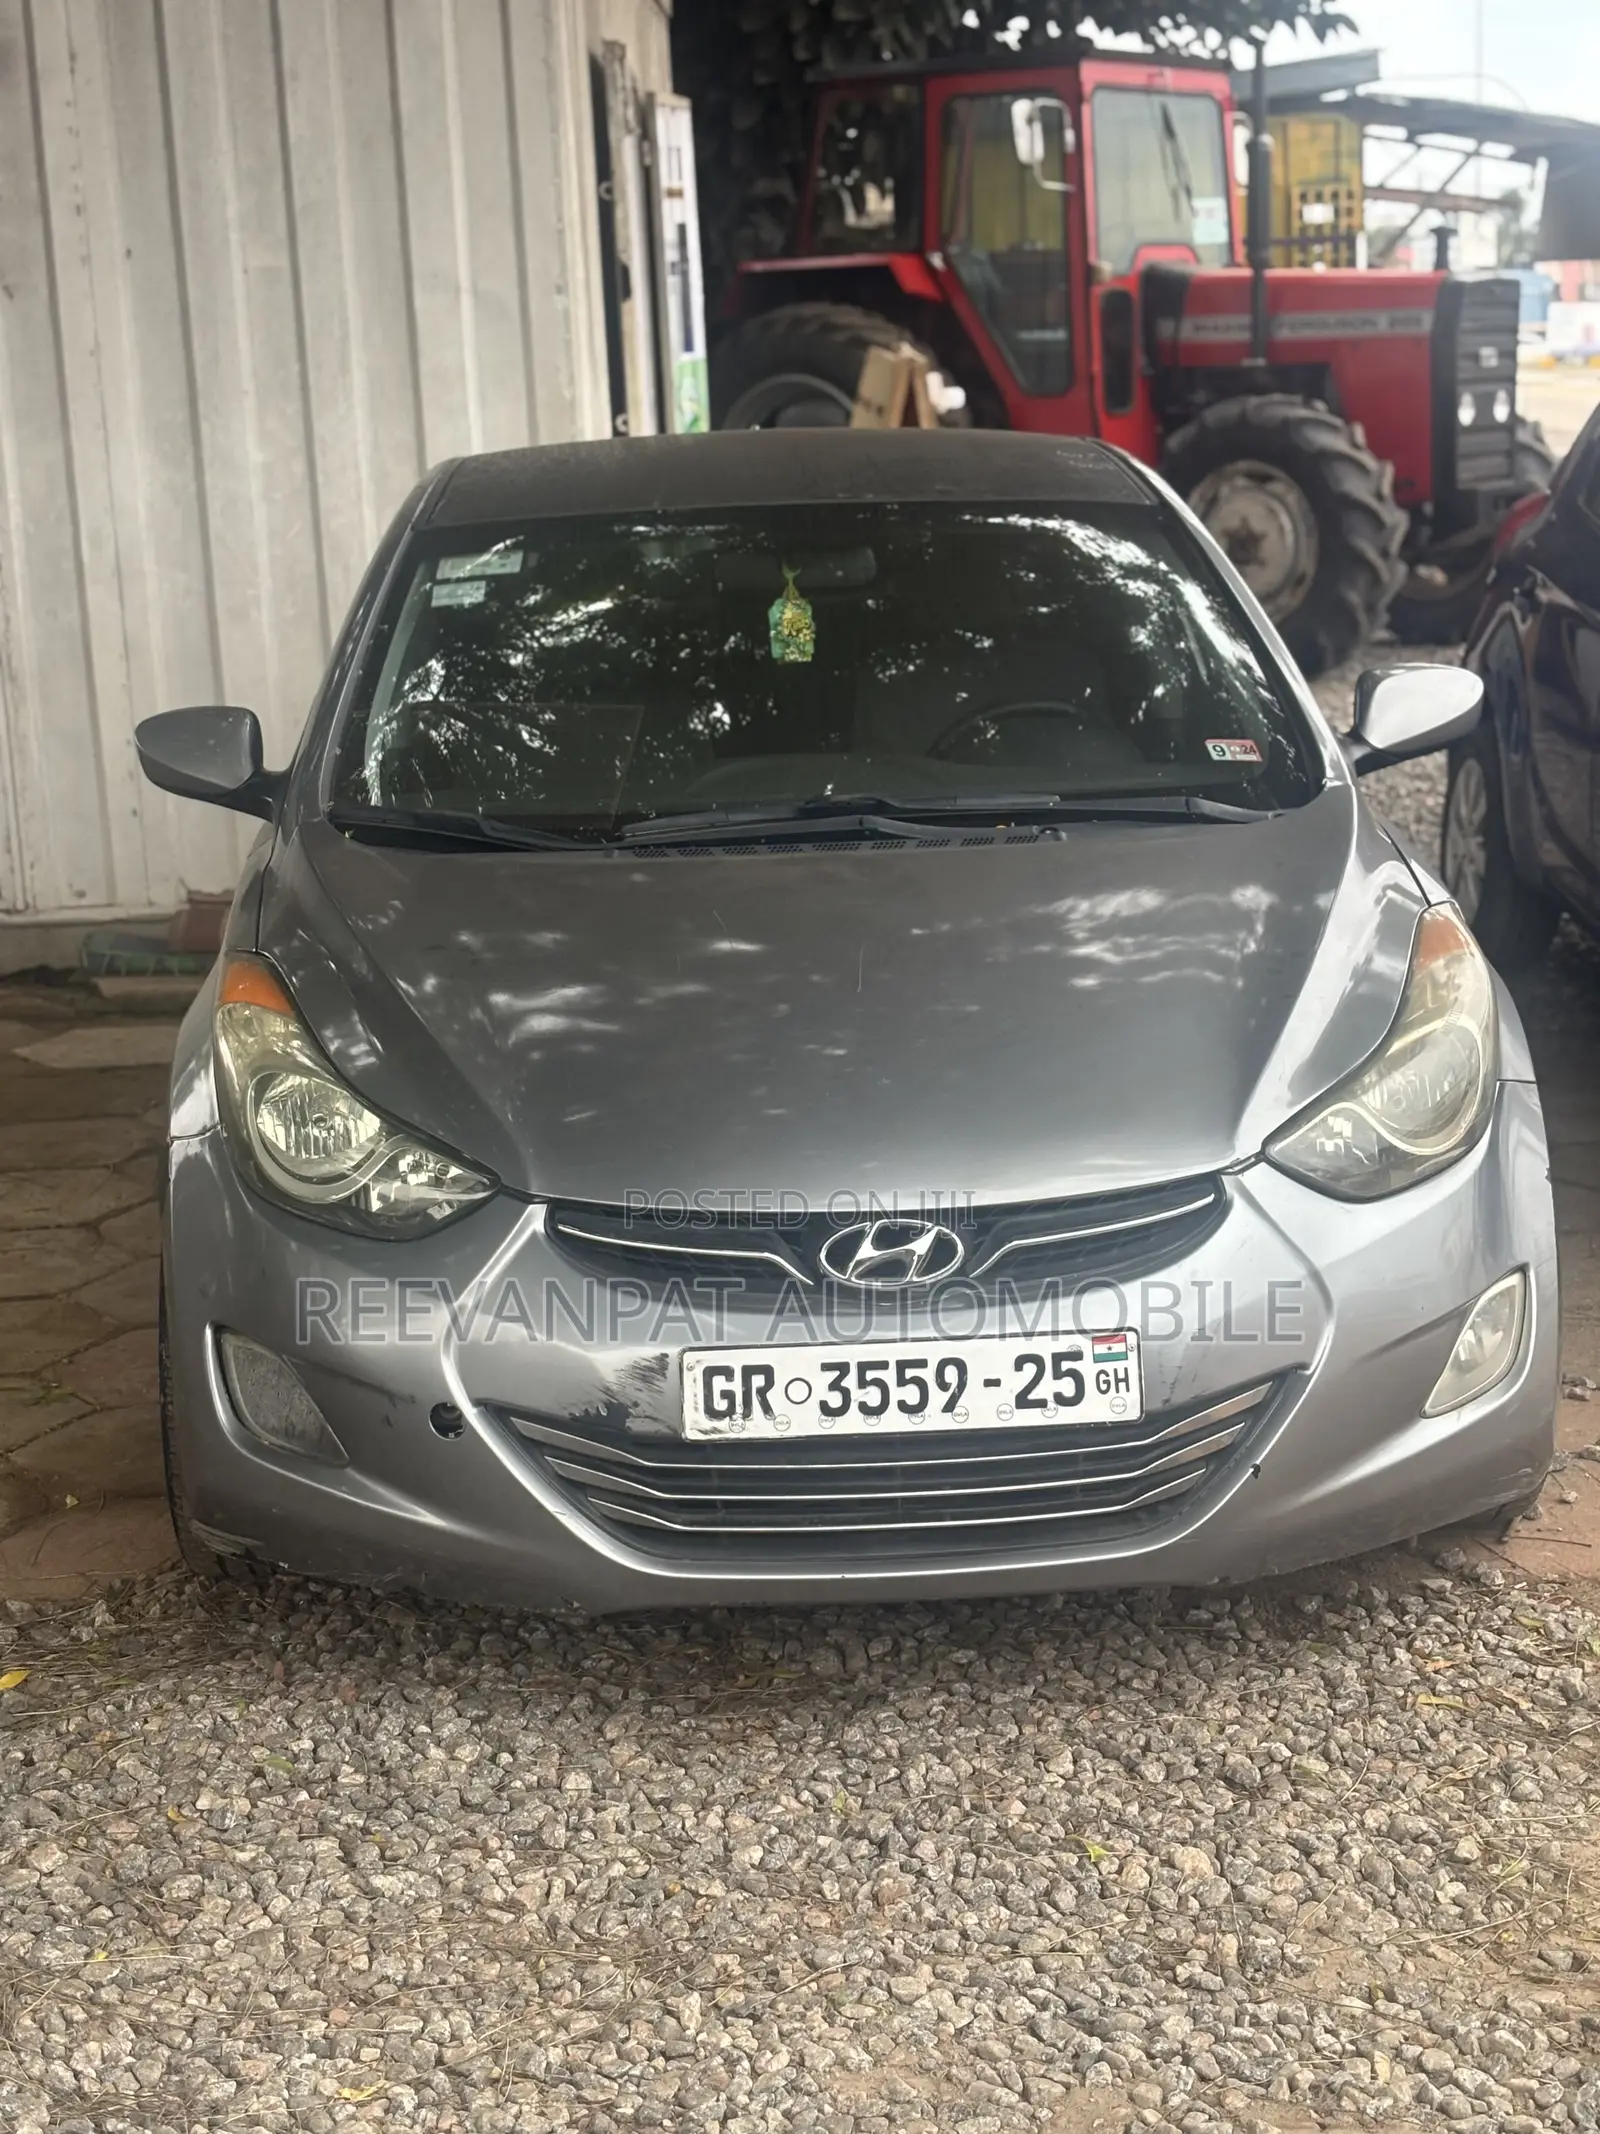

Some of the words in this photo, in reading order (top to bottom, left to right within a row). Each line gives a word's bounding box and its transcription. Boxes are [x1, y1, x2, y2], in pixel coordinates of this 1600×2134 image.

[1212, 744, 1226, 757] 9
[702, 1364, 775, 1419] GR
[1095, 1367, 1130, 1395] GH
